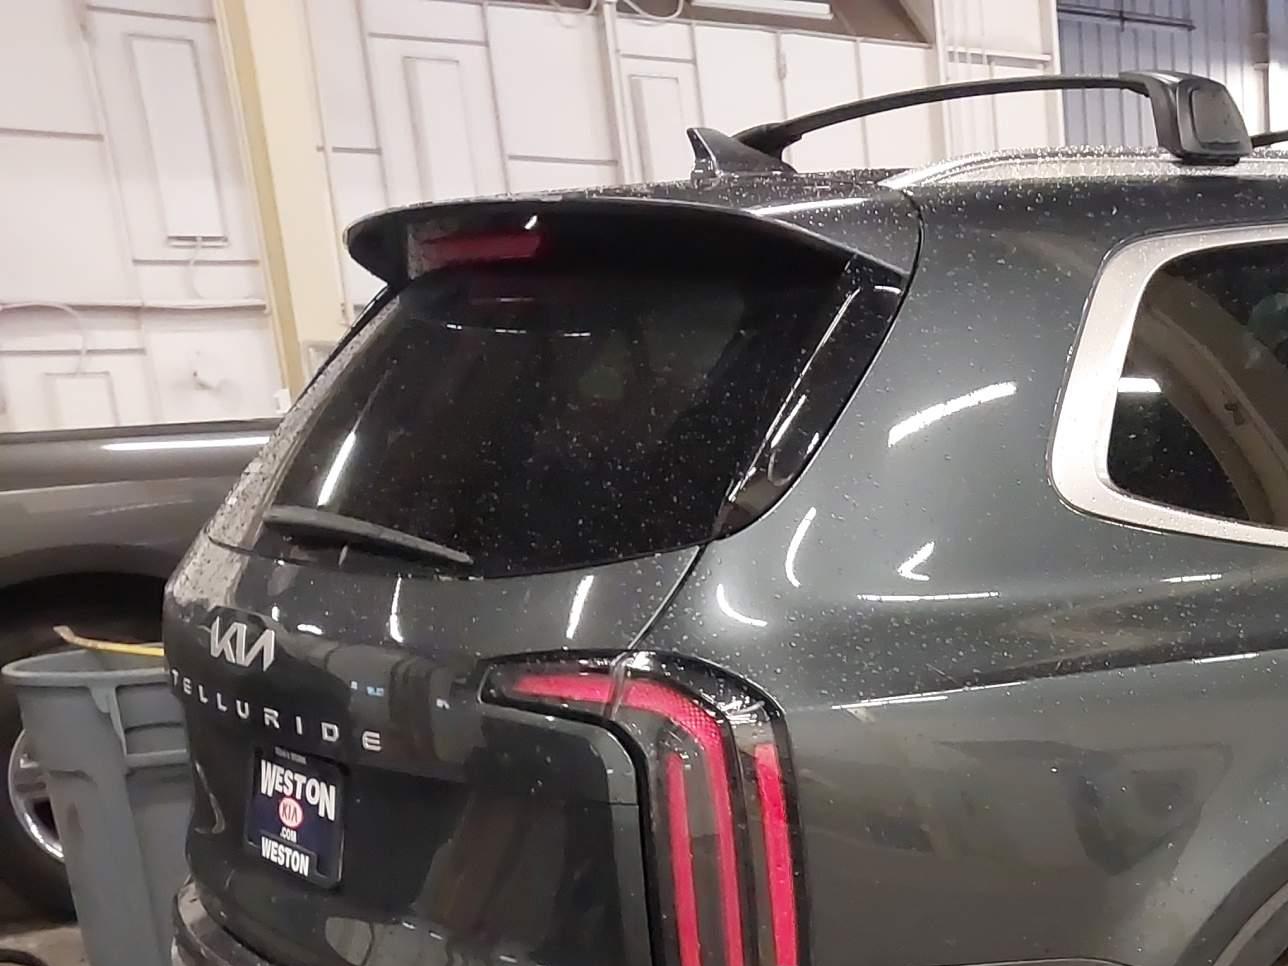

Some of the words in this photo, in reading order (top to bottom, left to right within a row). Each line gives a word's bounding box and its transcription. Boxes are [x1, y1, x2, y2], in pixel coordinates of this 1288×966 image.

[210, 615, 276, 672] KIA
[171, 668, 383, 752] TELLURIDE
[260, 759, 337, 821] WESTON
[261, 836, 310, 877] WESTON
